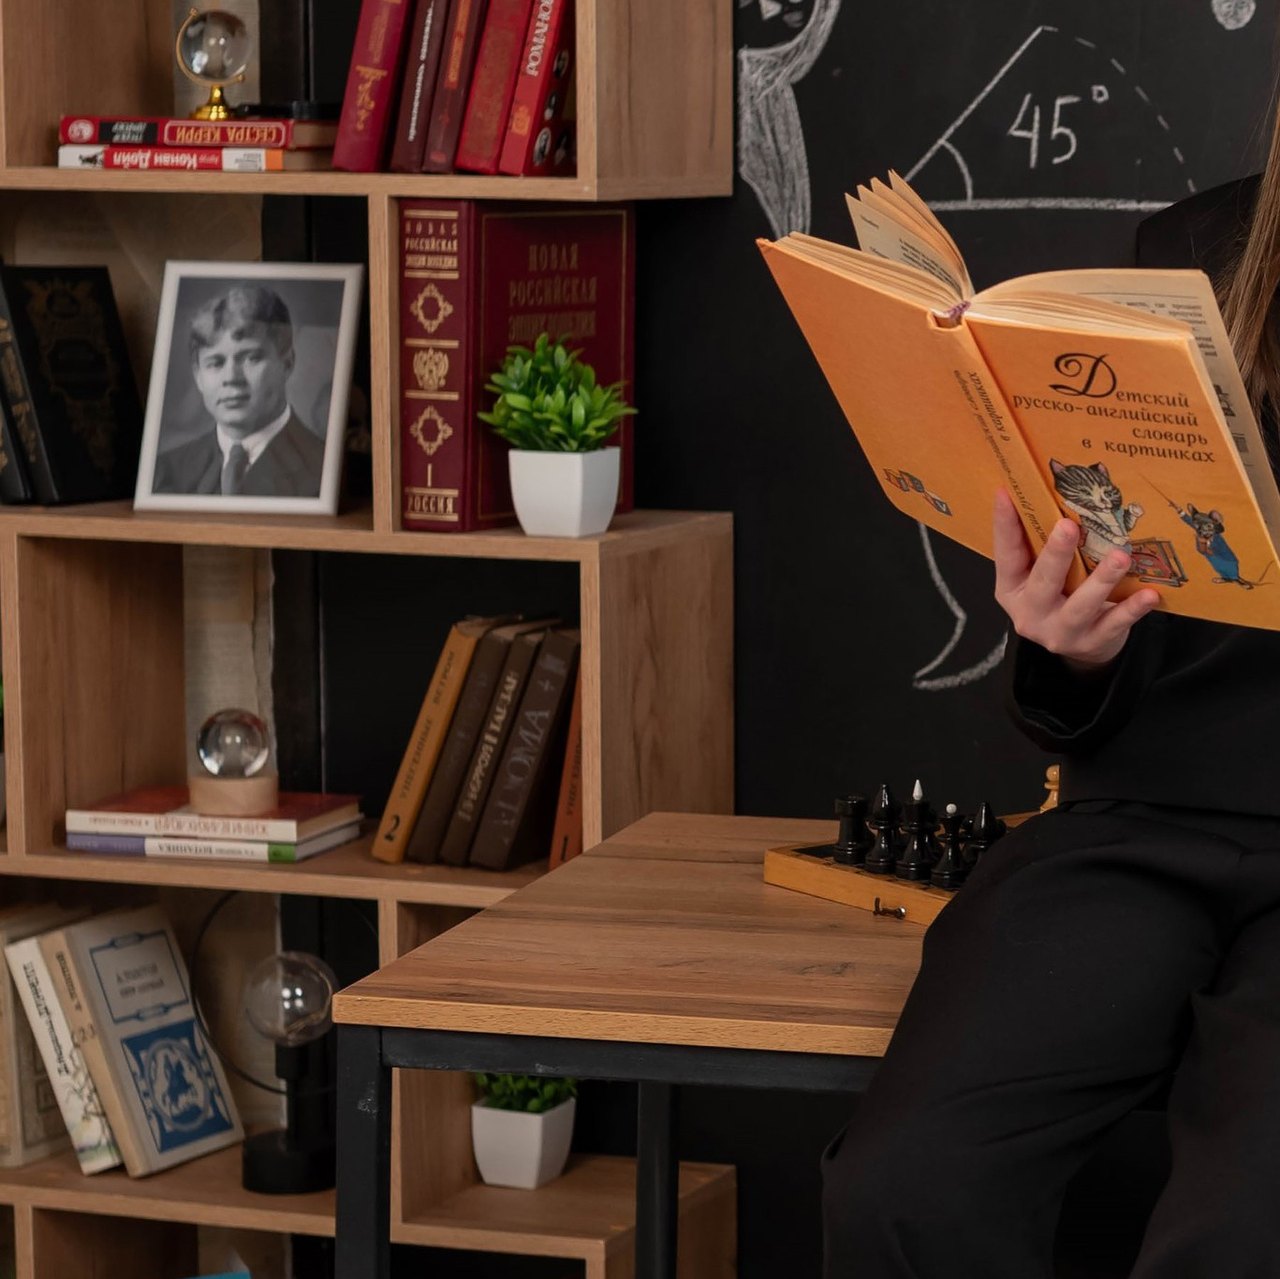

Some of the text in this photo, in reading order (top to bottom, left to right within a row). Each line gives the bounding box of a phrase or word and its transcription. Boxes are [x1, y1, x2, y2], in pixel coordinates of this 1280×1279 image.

[176, 124, 278, 144] СЕСТРА КЕРРИ
[113, 151, 149, 170] Дойл
[153, 151, 198, 169] Конан
[508, 275, 597, 308] РОССИЙСКАЯ
[1048, 352, 1190, 409] Детский
[968, 370, 1006, 432] картинках
[1012, 392, 1199, 428] русско-английский
[1132, 427, 1208, 447] словарь
[1082, 438, 1216, 464] в картинках
[408, 494, 454, 515] РОССИЯ
[384, 813, 401, 843] 2
[157, 841, 213, 855] БОТАНИКА
